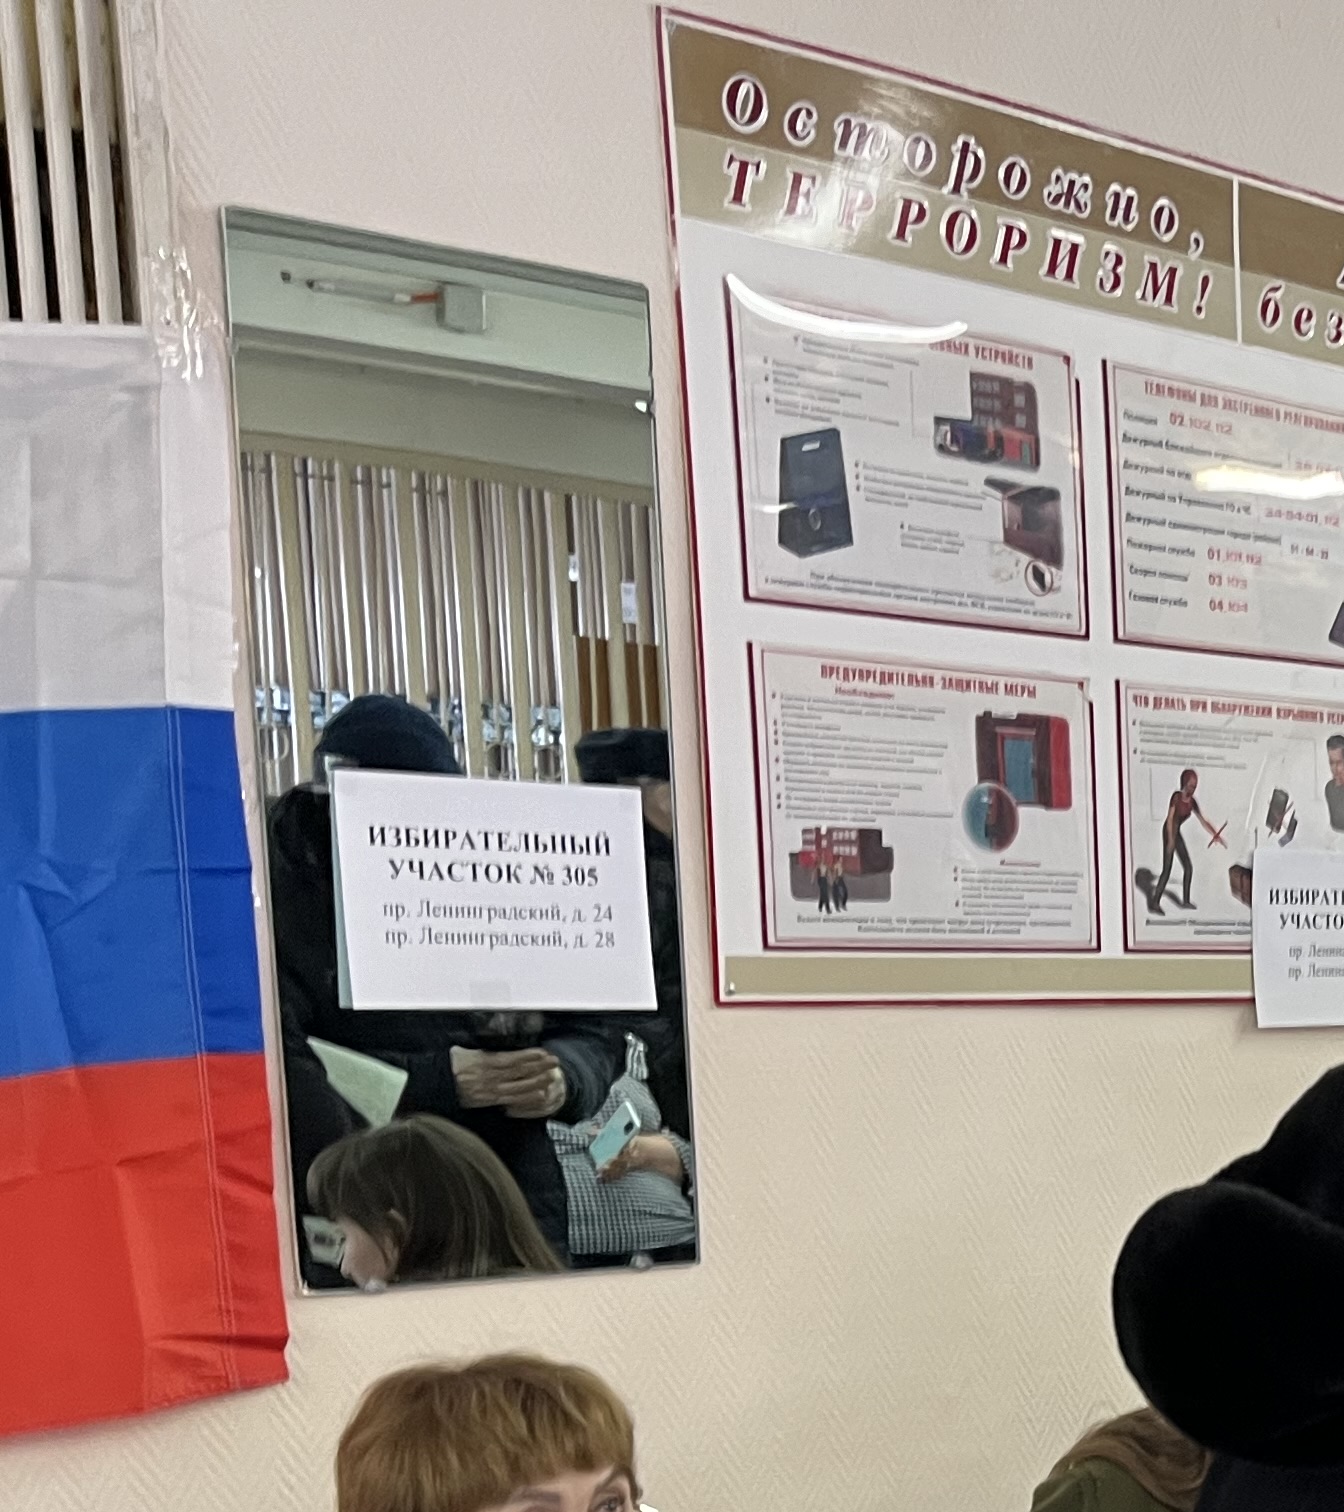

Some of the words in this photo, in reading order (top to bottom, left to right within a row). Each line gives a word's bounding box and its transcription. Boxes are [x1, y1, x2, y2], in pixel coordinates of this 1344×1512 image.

[721, 71, 1206, 259] Осторожно,
[723, 152, 1213, 317] ТЕРРОРИЗМ!
[1003, 683, 1038, 699] МЕРЫ
[1132, 693, 1149, 710] ЧТО
[1152, 695, 1187, 713] ДЕЛАТЬ
[1190, 699, 1208, 713] ПРИ
[367, 823, 611, 857] ИЗБИРАТЕЛЬНЫЙ
[388, 858, 523, 885] УЧАСТОК
[529, 865, 555, 886] №
[562, 865, 600, 888] 305
[382, 902, 411, 926] пр.
[416, 900, 568, 924] Ленинградский,
[592, 903, 613, 923] 24
[384, 929, 413, 950] пр.
[418, 926, 568, 951] Ленинградский,
[594, 930, 616, 949] 28
